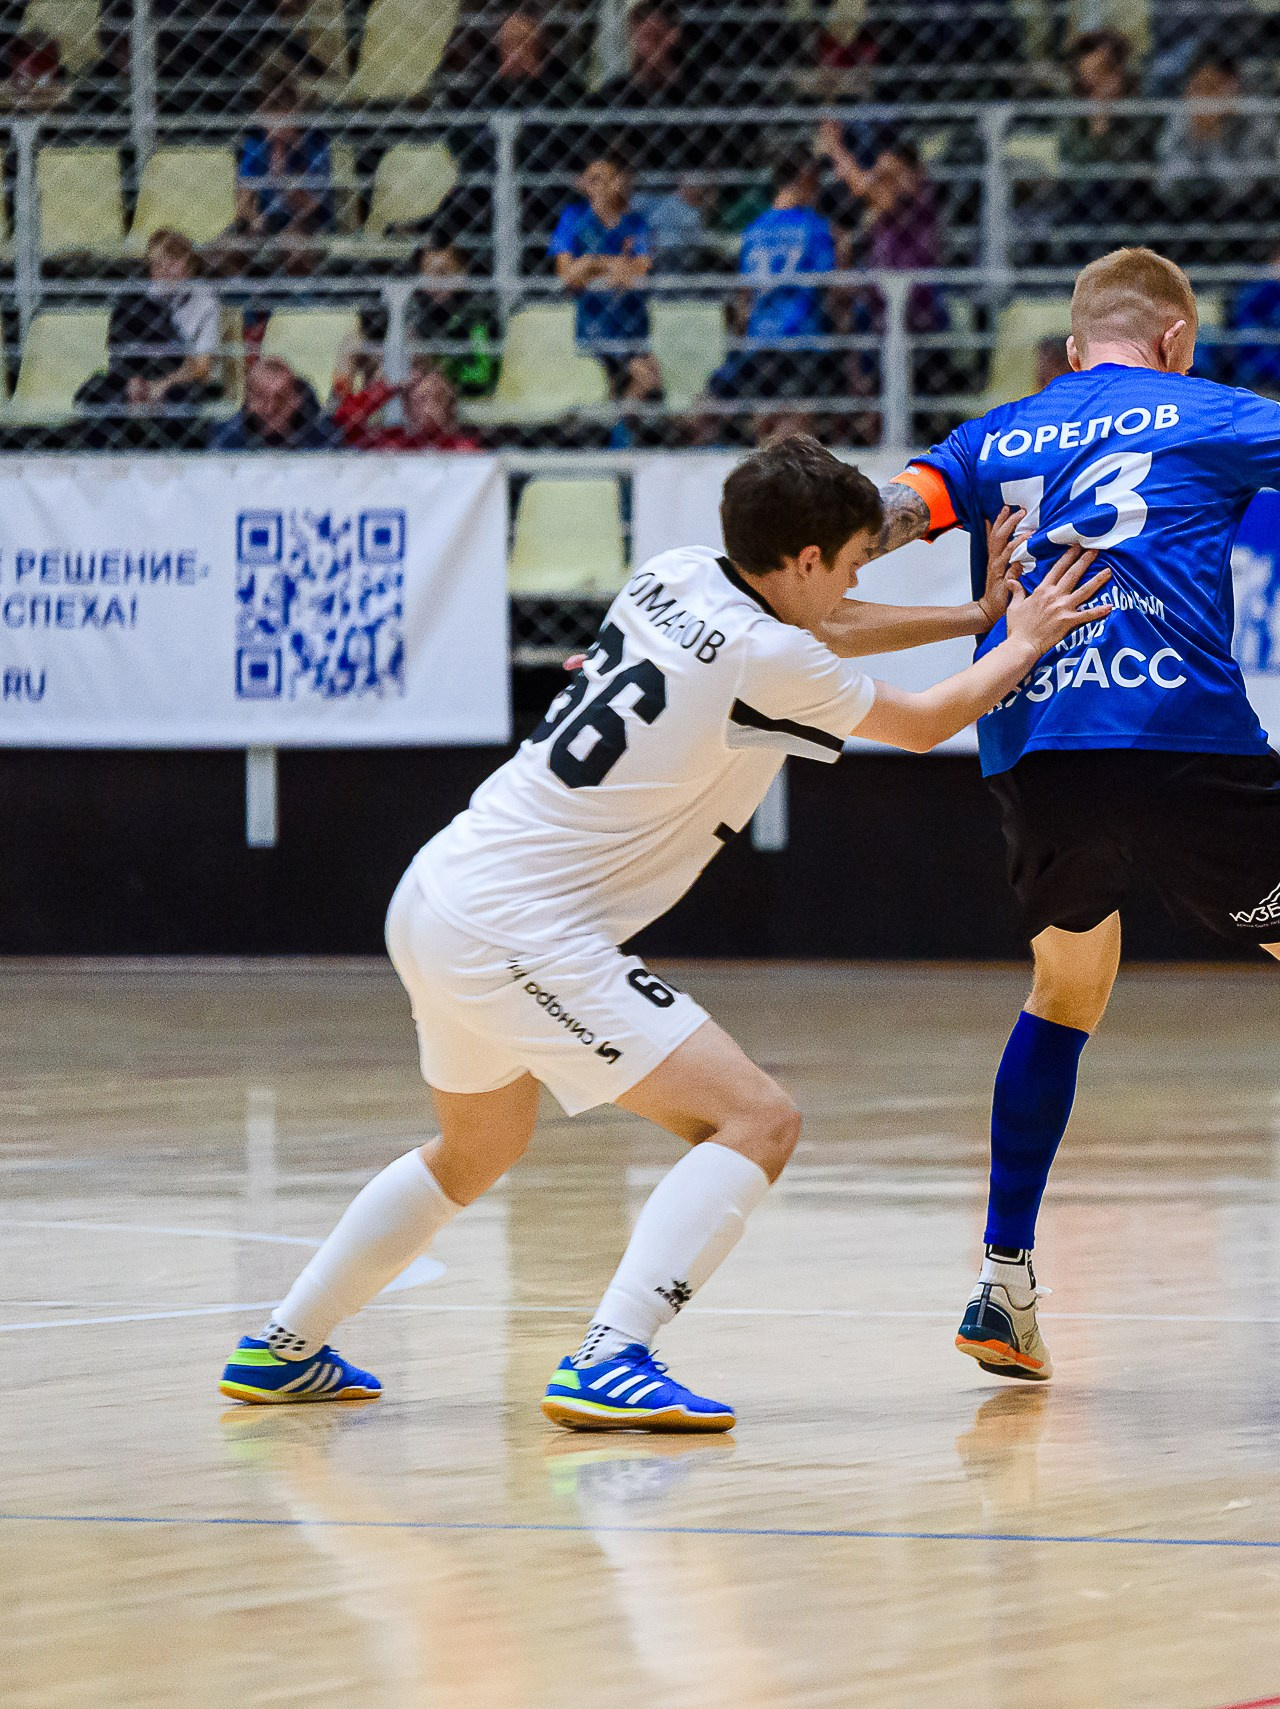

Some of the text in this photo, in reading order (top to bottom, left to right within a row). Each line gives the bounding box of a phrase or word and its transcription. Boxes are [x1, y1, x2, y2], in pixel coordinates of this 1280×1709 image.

[979, 404, 1180, 461] ГОРЕЛОВ
[1000, 451, 1153, 576] 13
[526, 620, 667, 790] 66
[987, 647, 1187, 715] ЗБАСС
[523, 980, 596, 1046] синара
